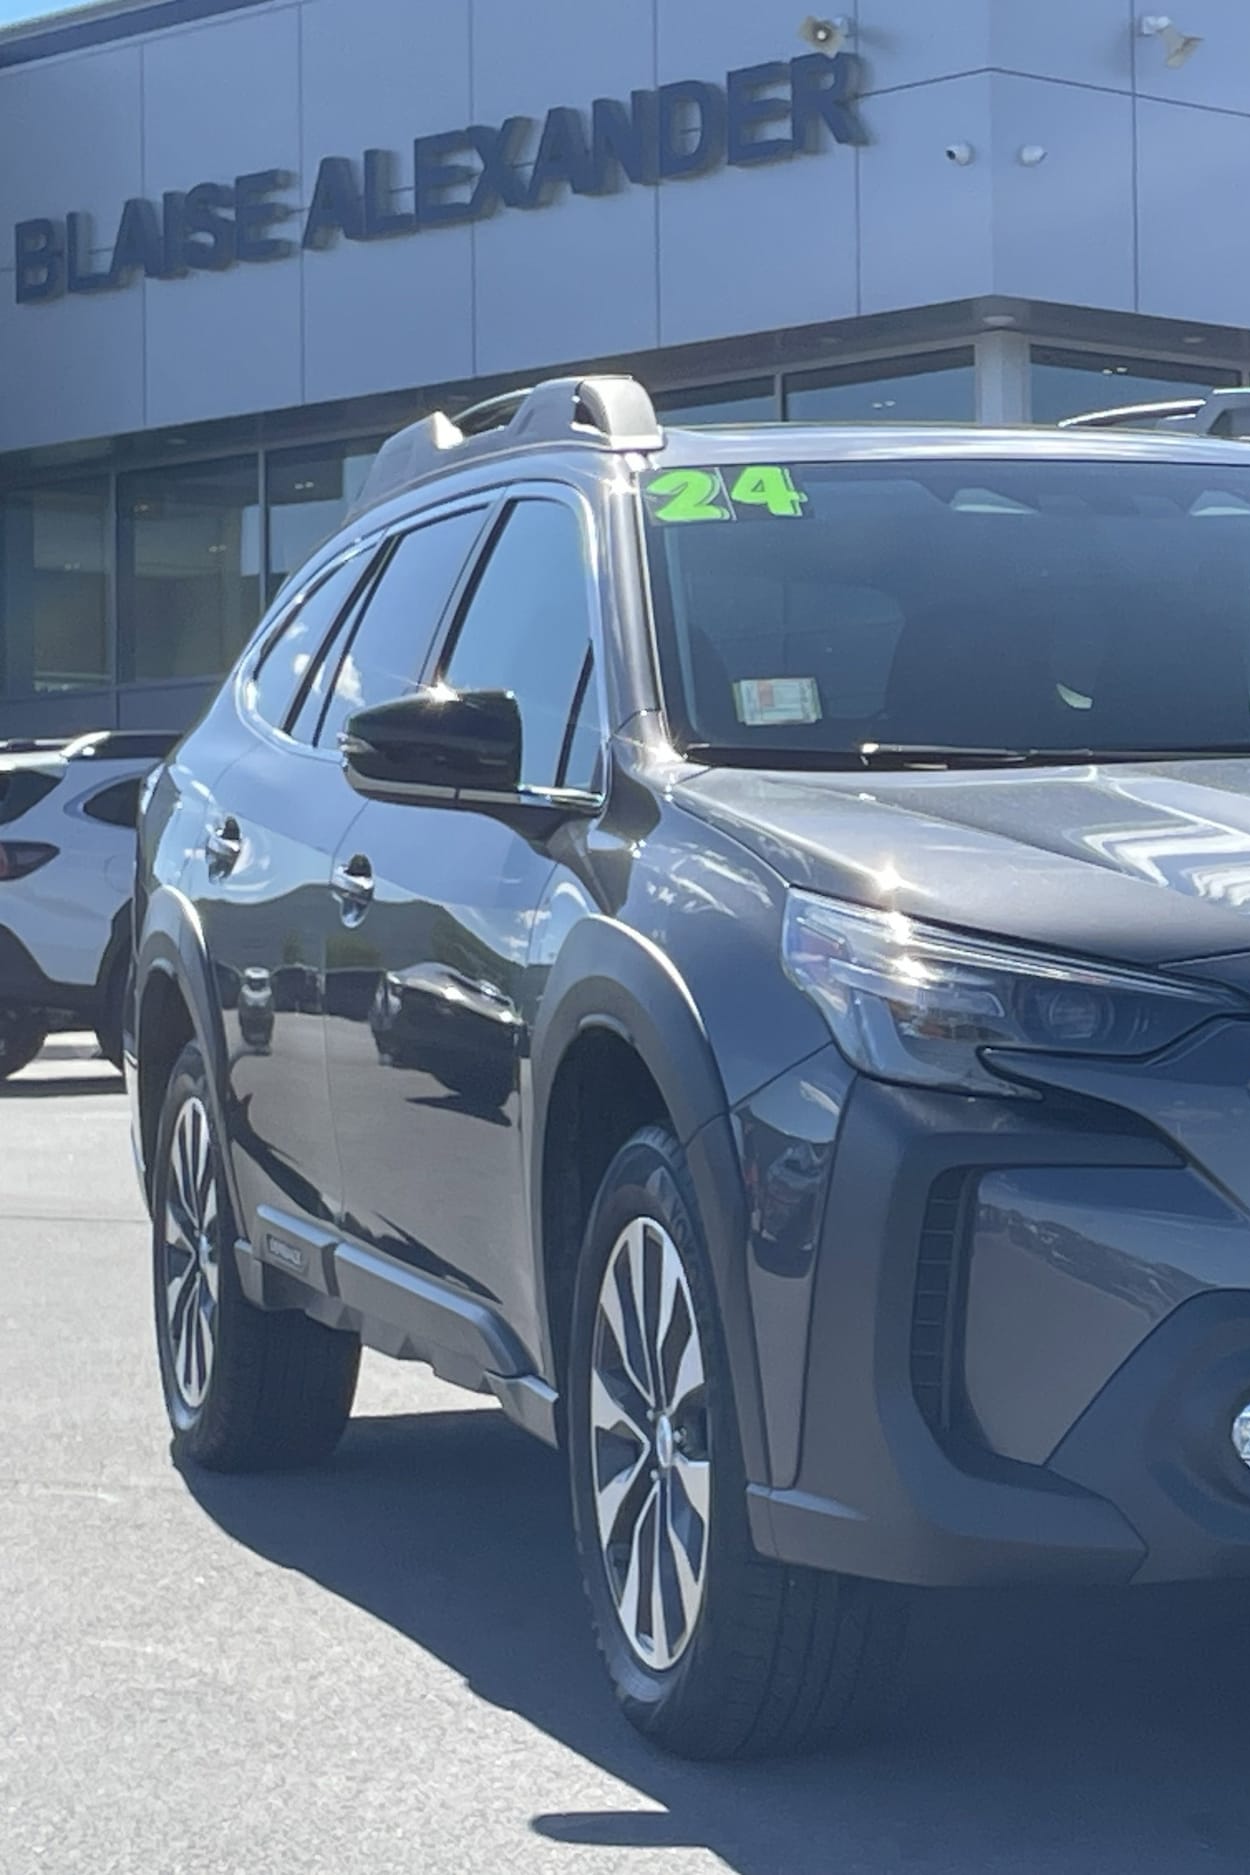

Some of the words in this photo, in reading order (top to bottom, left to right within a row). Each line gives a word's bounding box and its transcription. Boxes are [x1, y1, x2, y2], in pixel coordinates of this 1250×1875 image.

[14, 168, 298, 305] BLAISE
[302, 51, 869, 251] ALEXANDER
[646, 465, 808, 523] 24
